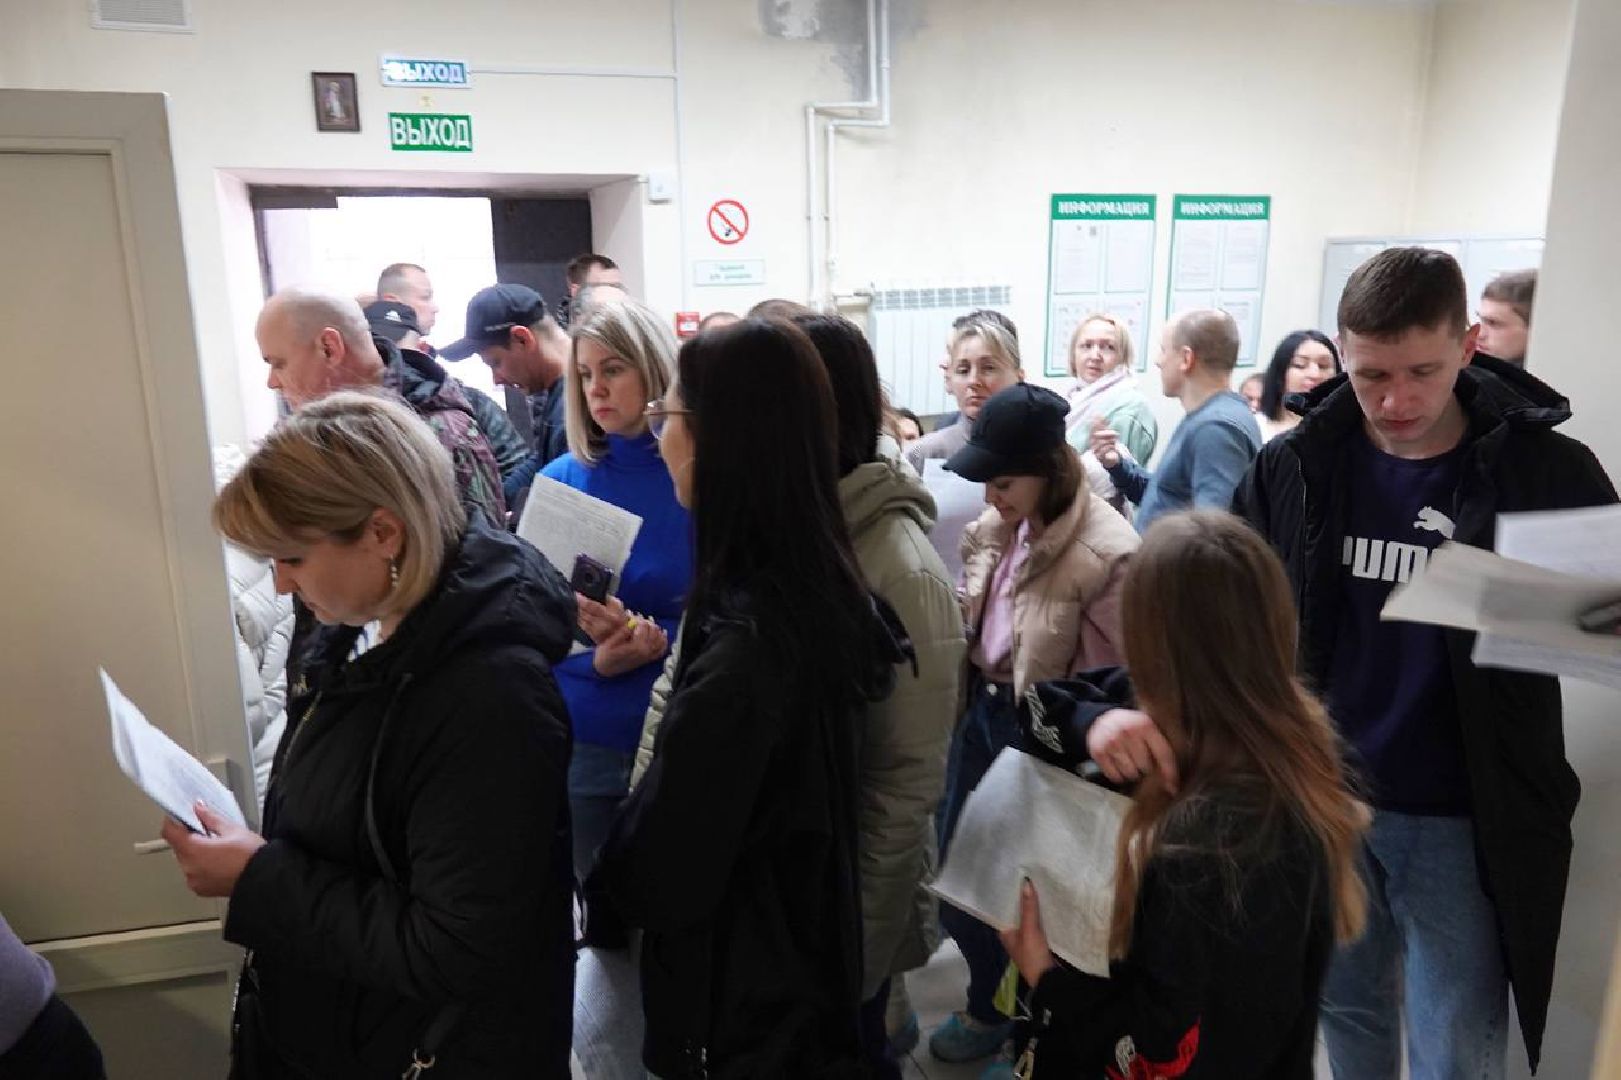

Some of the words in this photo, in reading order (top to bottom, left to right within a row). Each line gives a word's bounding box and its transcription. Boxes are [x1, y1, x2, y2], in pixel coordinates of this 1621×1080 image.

[391, 117, 469, 148] ВЫХОД
[1058, 201, 1149, 217] ИНФОРМАЦИЯ
[1180, 201, 1264, 217] ИНФОРМАЦИЯ
